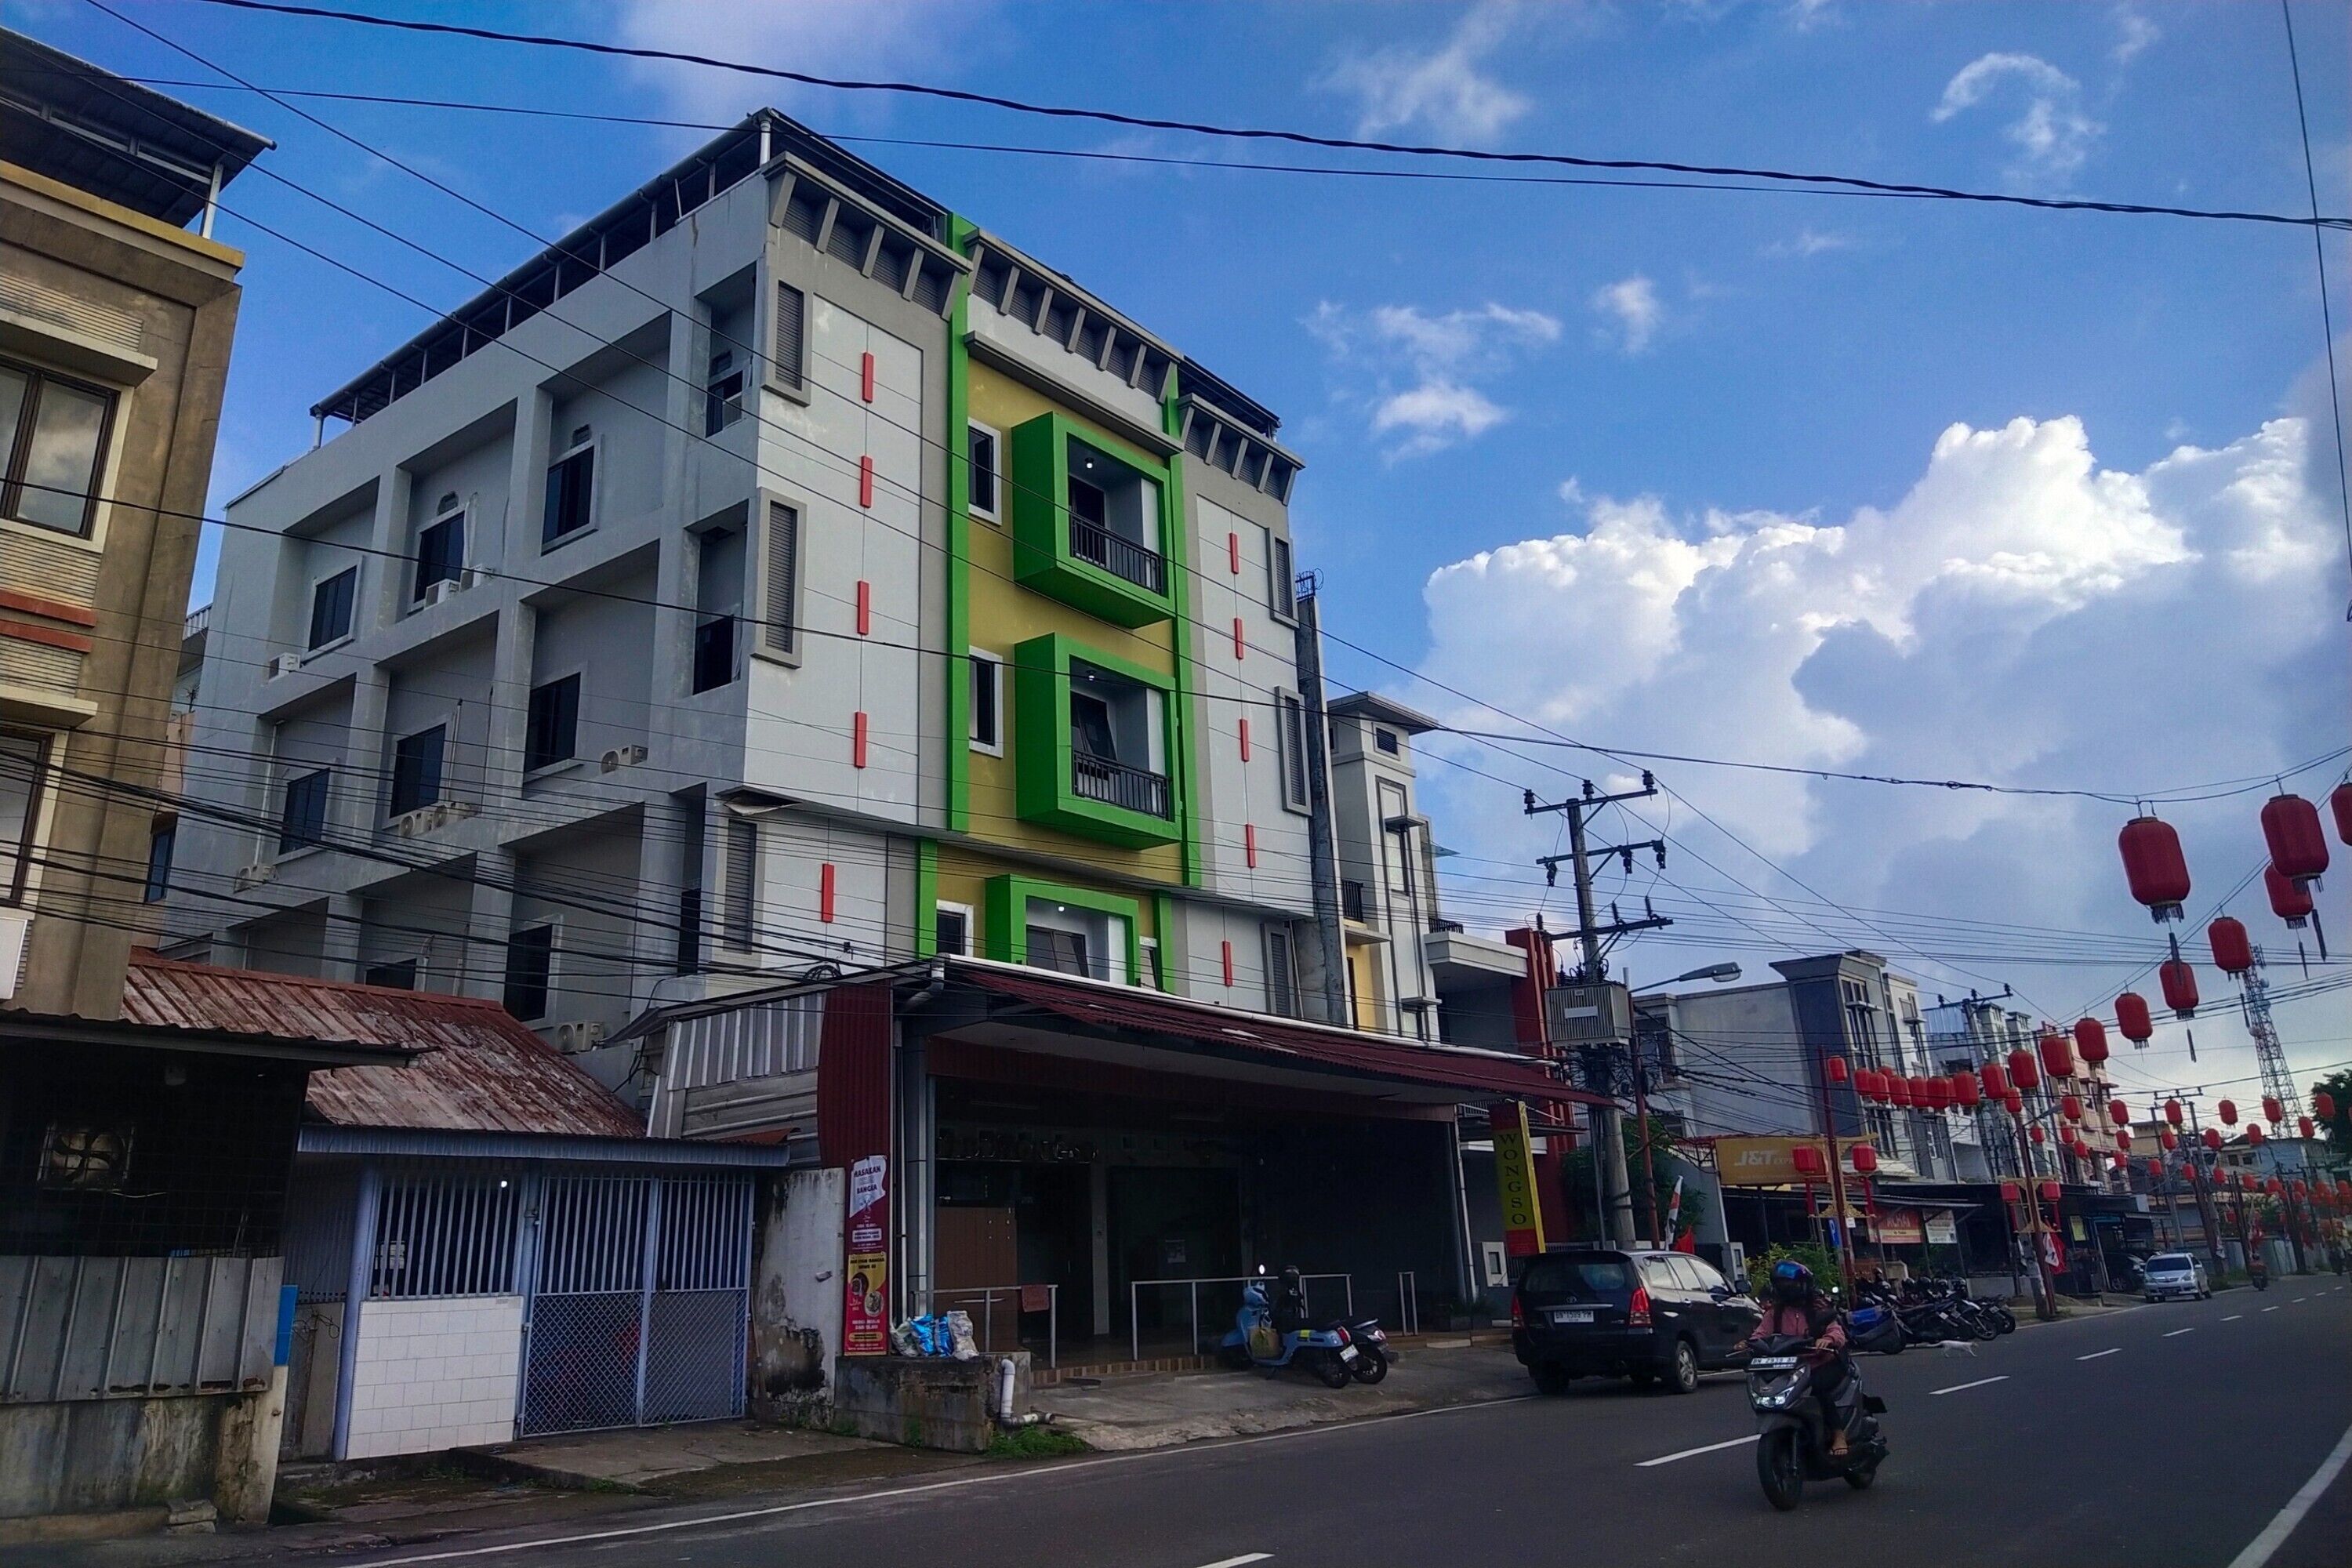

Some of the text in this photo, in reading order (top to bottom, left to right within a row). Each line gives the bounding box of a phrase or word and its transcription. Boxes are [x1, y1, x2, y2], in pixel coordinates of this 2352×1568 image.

[1734, 1149, 1779, 1167] J&T
[854, 1165, 881, 1178] MASAKAN
[1499, 1134, 1527, 1225] WONGSO
[856, 1184, 877, 1194] BANGKA
[1828, 1219, 1836, 1242] P
